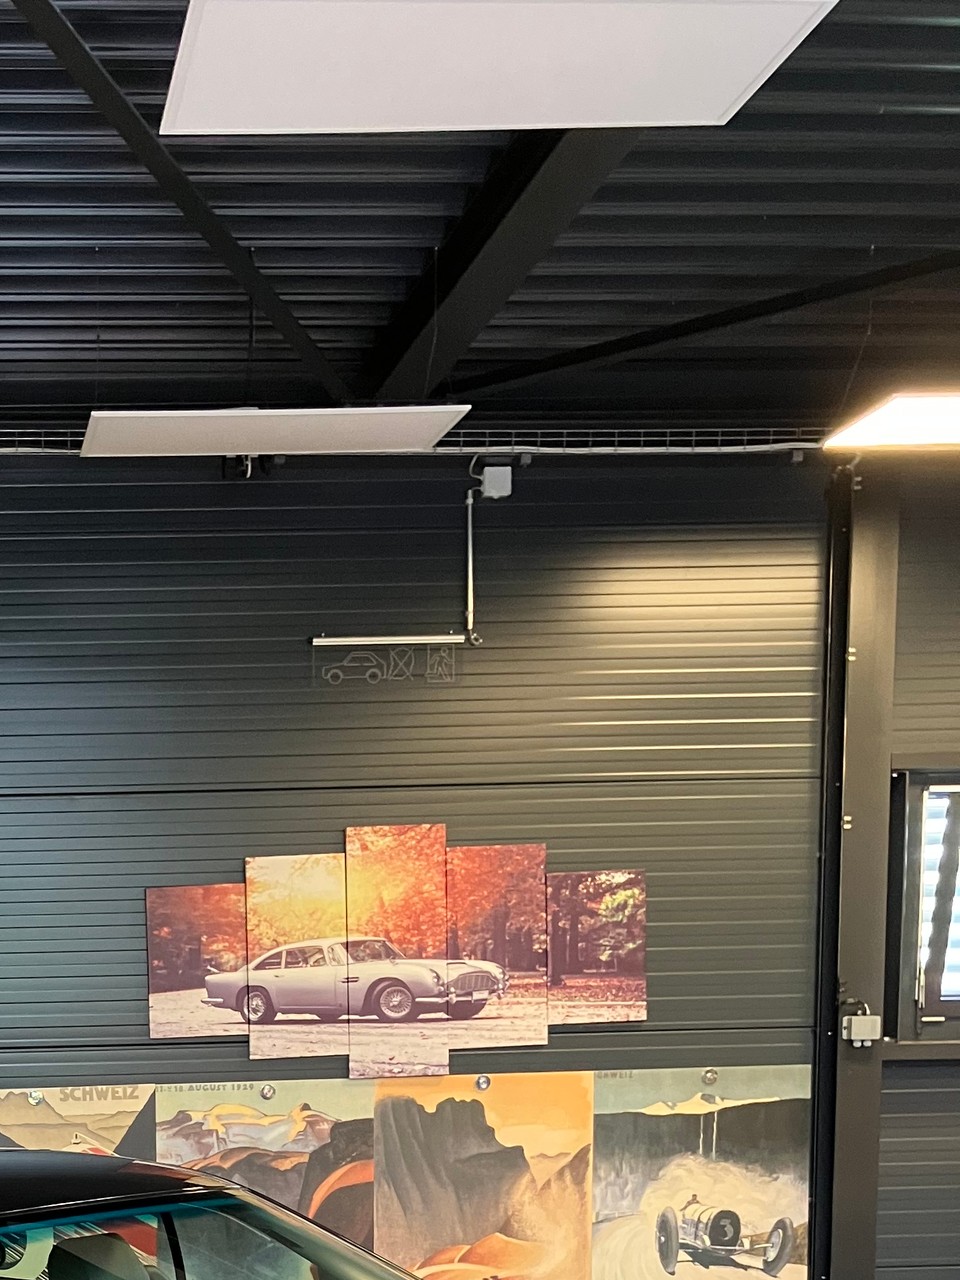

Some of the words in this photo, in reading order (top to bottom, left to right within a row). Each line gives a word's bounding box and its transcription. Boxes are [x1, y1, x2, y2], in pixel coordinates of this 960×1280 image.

[59, 1085, 139, 1102] SCHWEIZ
[187, 1084, 228, 1092] AUGUST
[231, 1083, 255, 1091] 1929
